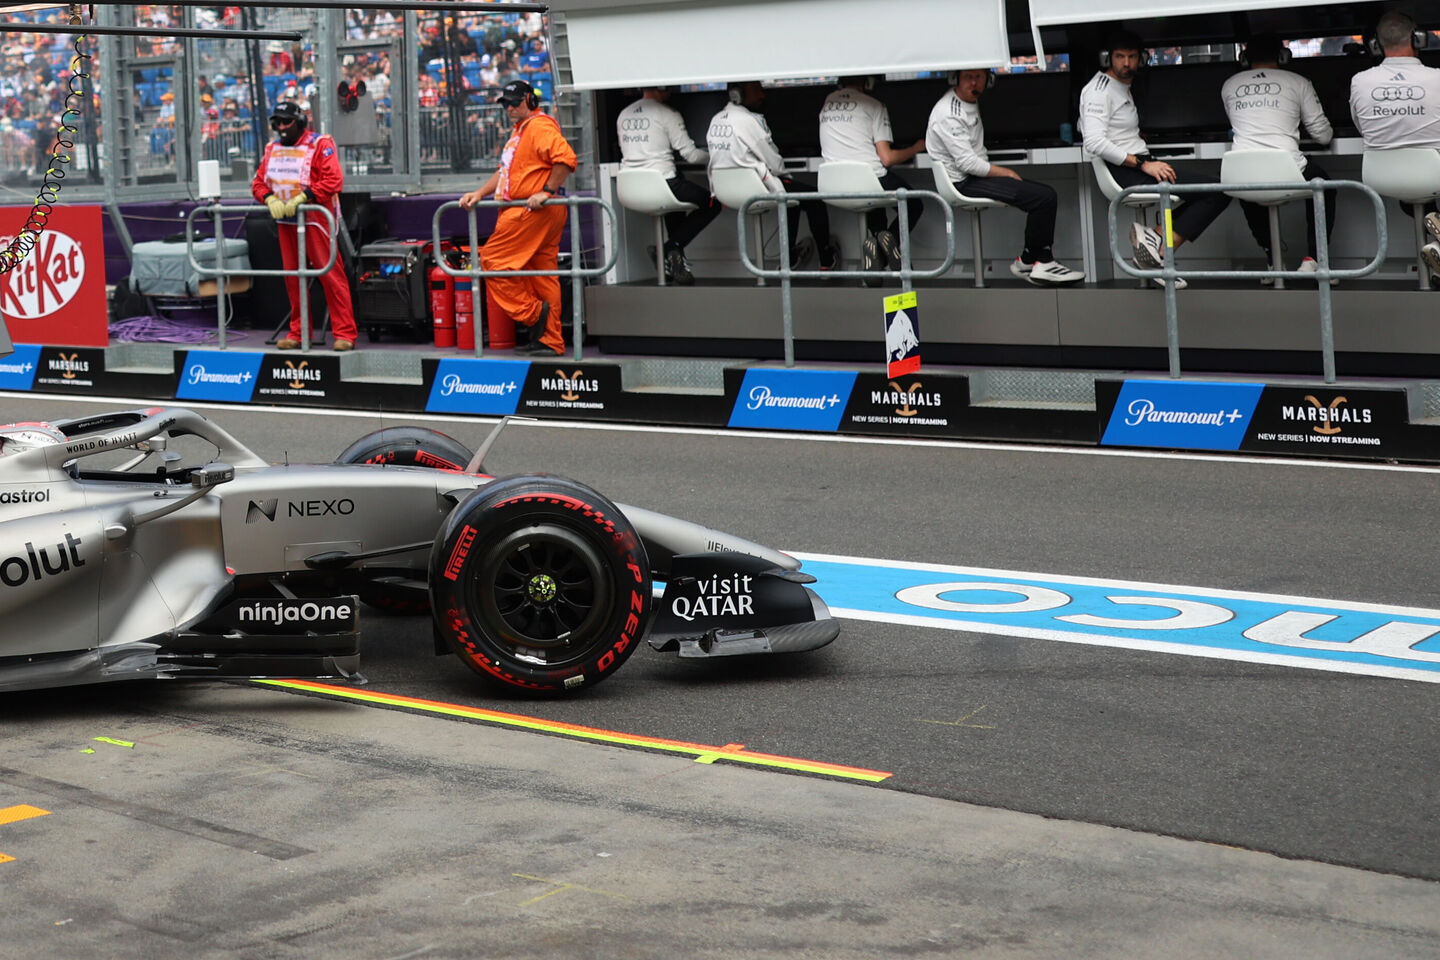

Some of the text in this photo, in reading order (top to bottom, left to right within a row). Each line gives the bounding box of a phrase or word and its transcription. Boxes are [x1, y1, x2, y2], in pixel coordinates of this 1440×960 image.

[1234, 98, 1281, 111] Revolut
[1372, 105, 1426, 116] Revolut
[48, 360, 89, 372] MARSHALS
[188, 364, 253, 385] Paramount+
[272, 368, 321, 381] MARSHALS
[440, 374, 517, 396] Paramount+
[541, 378, 599, 392] MARSHALS
[746, 385, 841, 411] Paramount+
[871, 390, 942, 407] MARSHALS
[909, 418, 948, 426] STREAMING
[1124, 399, 1243, 426] Paramount+
[1282, 405, 1372, 423] MARSHALS
[65, 432, 138, 454] WORLD OF HYATT
[1258, 433, 1381, 445] NEW SERIES NOW STREAMING
[288, 499, 355, 517] NEXO
[444, 524, 479, 582] PIRELLI
[697, 572, 753, 595] visit
[239, 602, 351, 626] ninjaOne
[596, 561, 644, 673] P ZERO
[671, 595, 755, 622] QATAR
